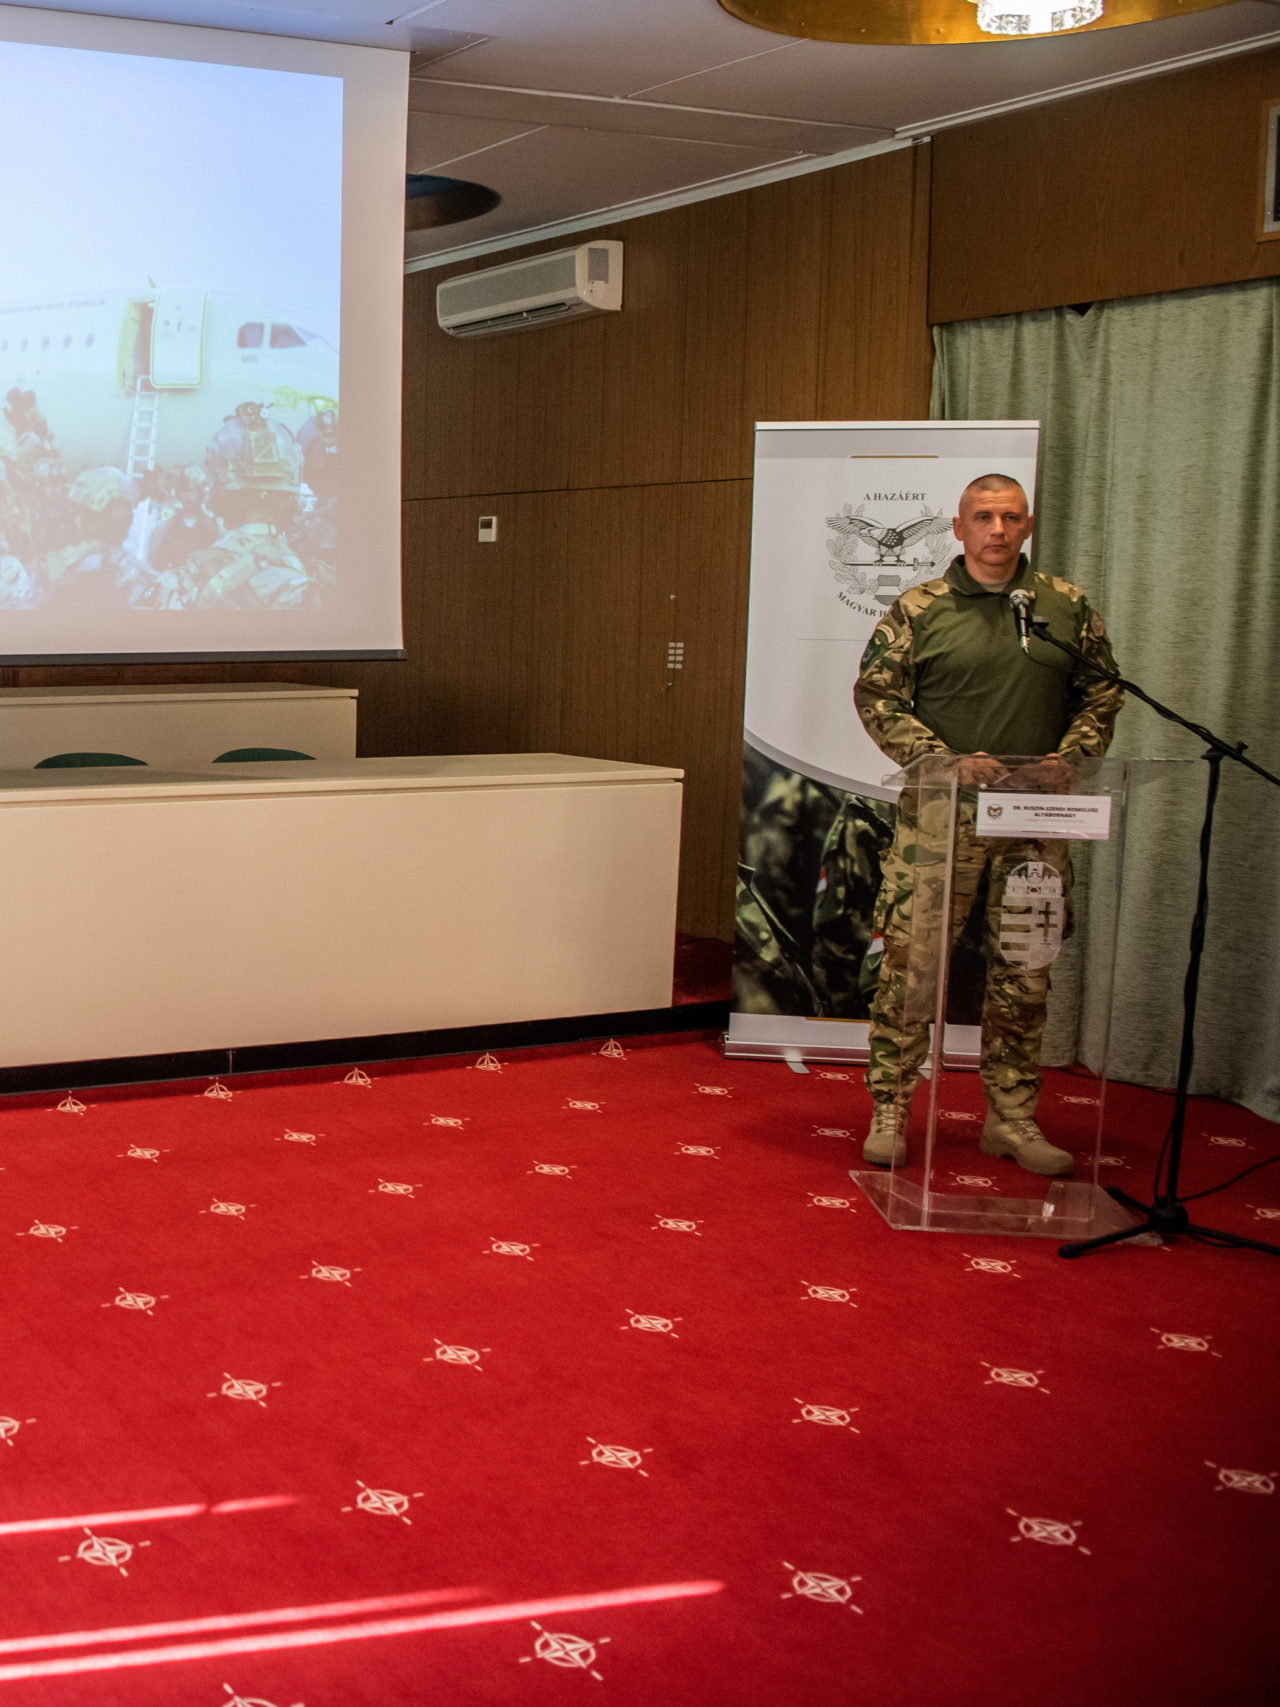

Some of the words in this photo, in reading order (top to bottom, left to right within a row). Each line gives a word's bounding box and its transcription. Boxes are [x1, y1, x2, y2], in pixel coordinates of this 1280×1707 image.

[863, 493, 871, 501] A
[873, 491, 927, 501] HAZÁÉRT
[836, 591, 877, 618] MAGYAR
